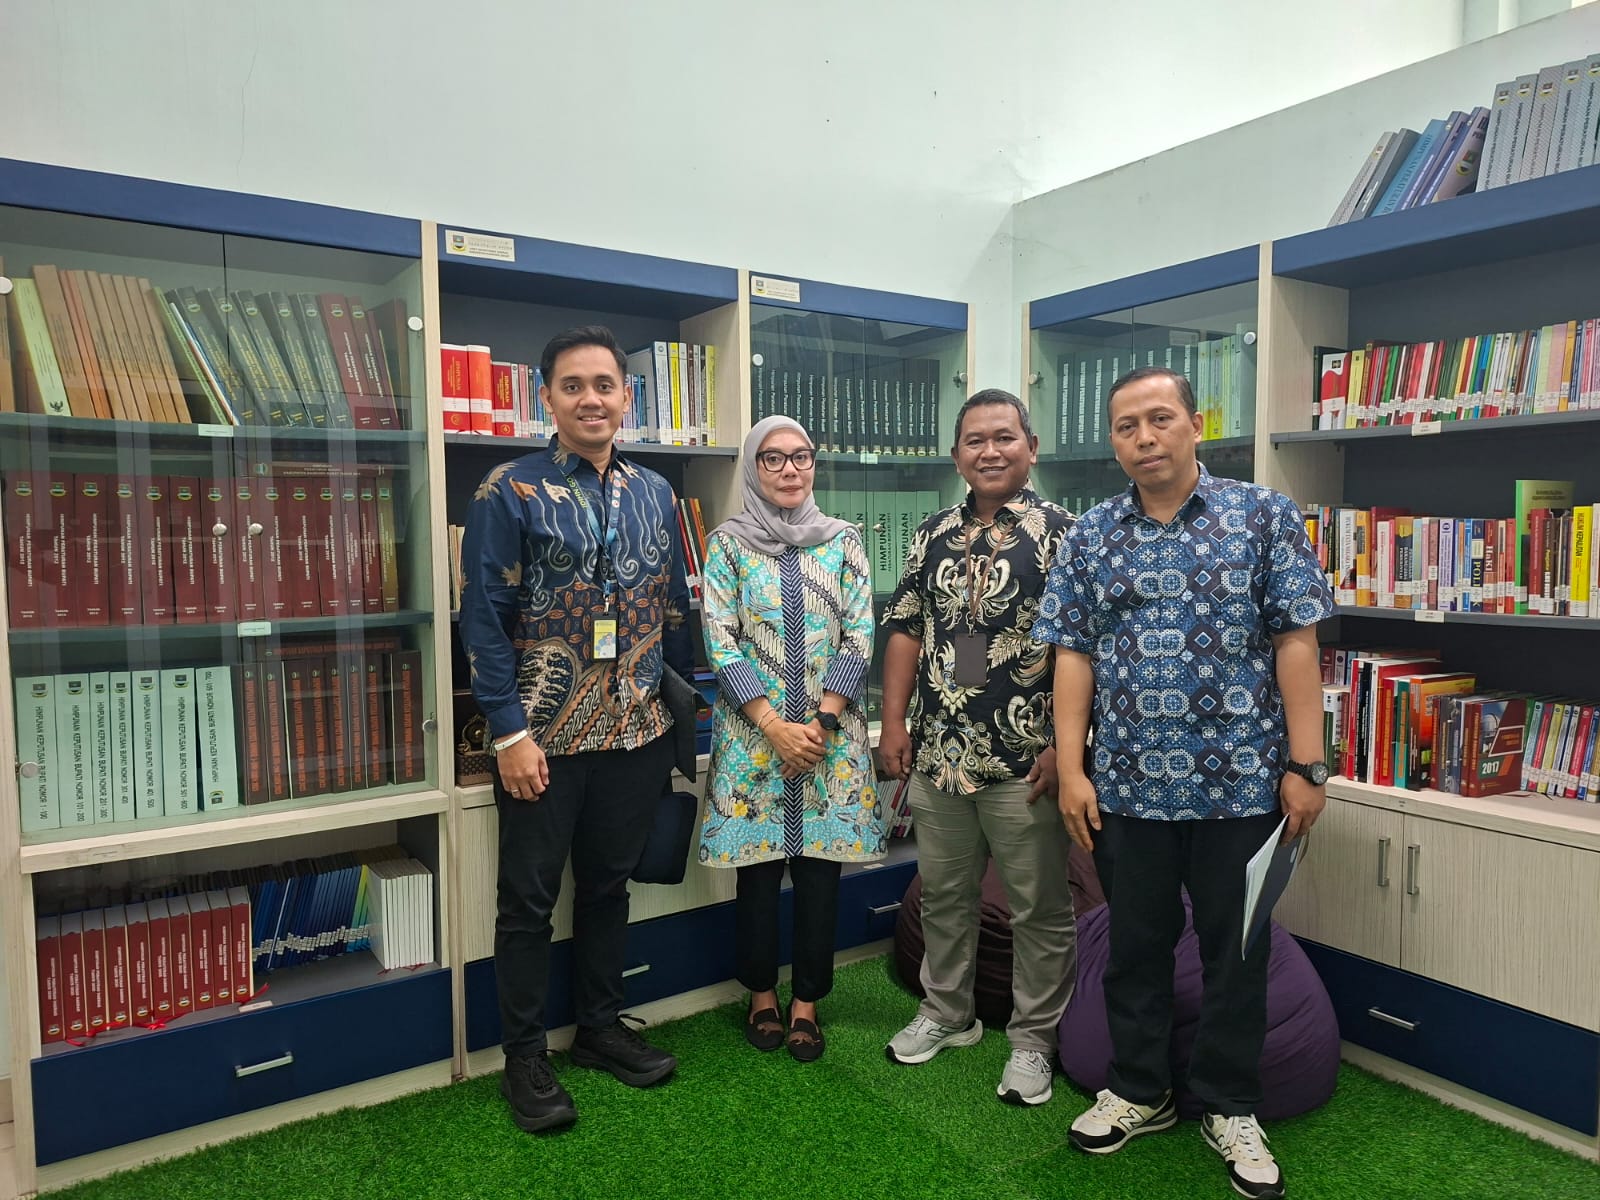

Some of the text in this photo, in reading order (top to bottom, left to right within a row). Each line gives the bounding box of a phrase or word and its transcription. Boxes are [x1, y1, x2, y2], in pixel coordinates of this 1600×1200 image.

[1486, 546, 1494, 571] HaKI
[1473, 562, 1481, 607] POLIK
[1482, 760, 1500, 774] 2017
